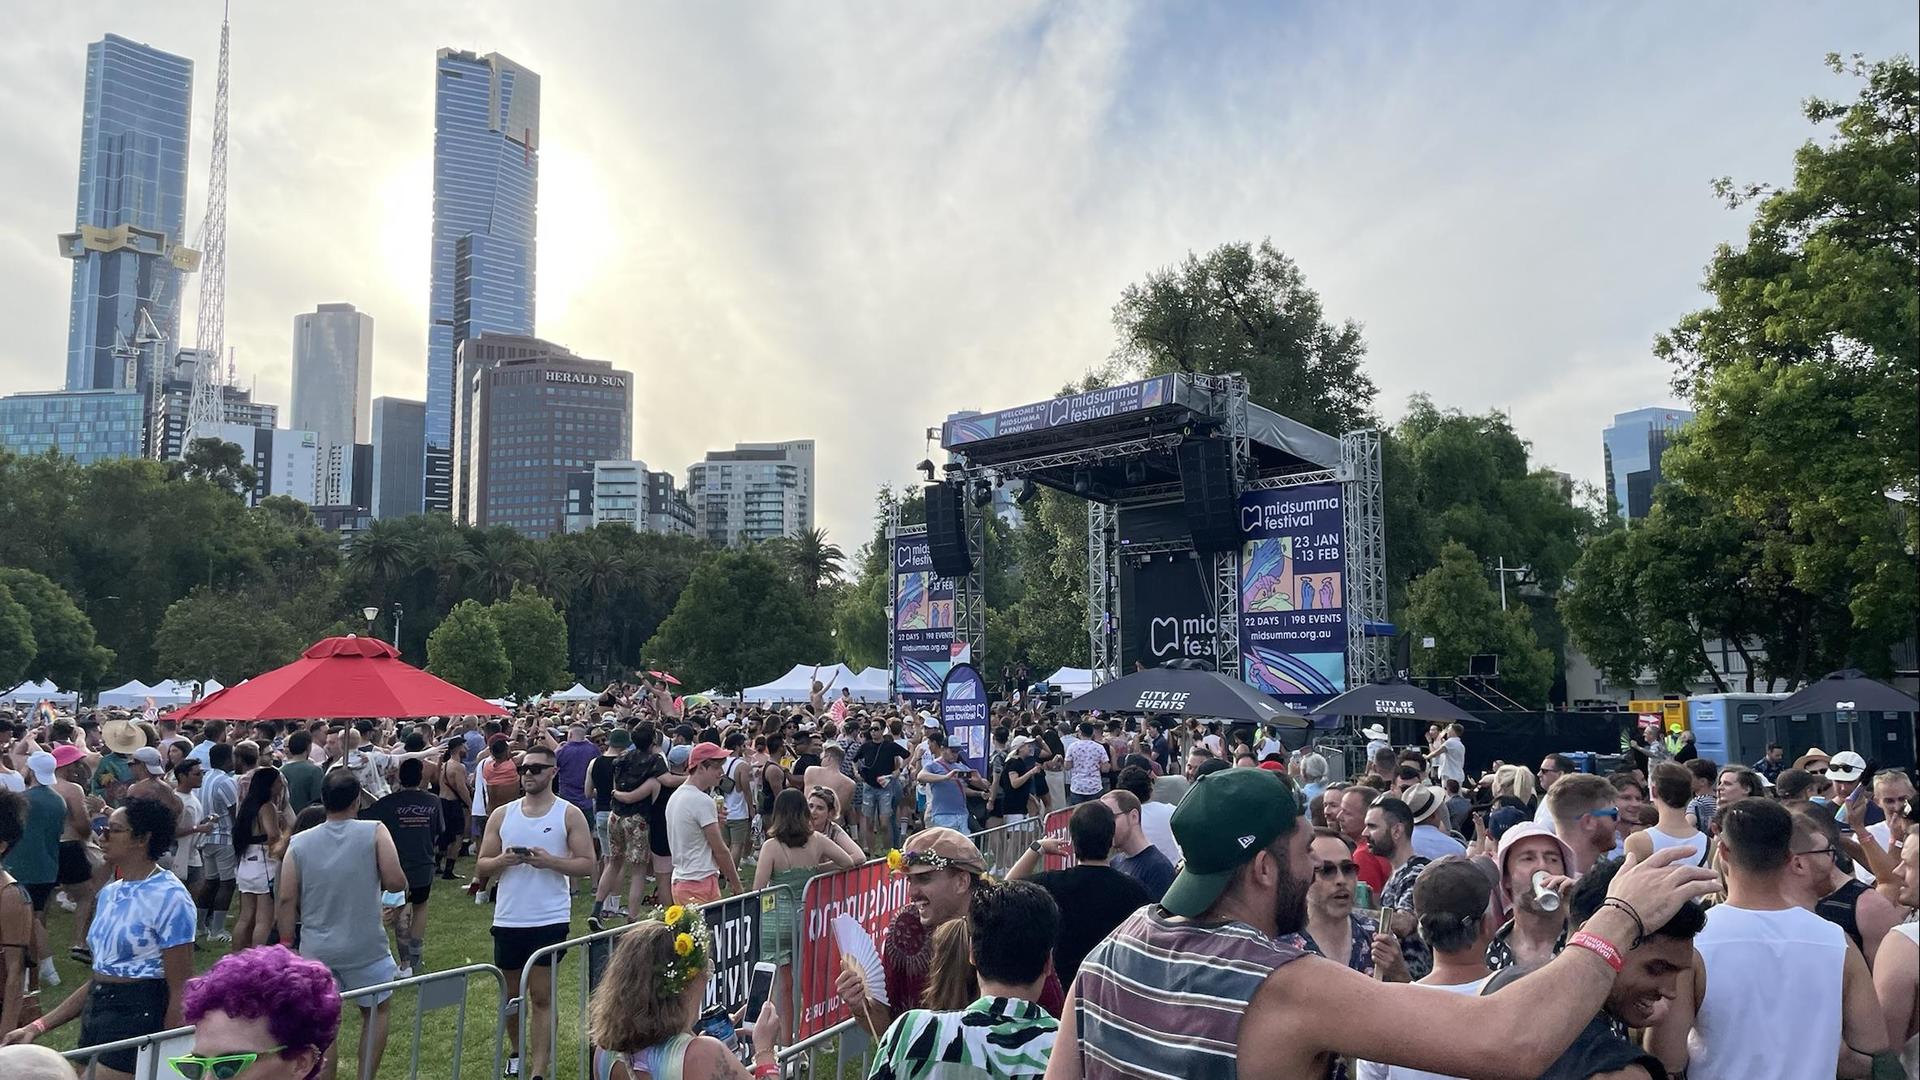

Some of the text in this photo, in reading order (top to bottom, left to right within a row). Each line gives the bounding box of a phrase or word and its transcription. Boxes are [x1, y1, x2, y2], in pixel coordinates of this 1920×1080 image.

[546, 372, 625, 386] HERALD SUN
[1071, 385, 1139, 409] midsumma
[1001, 408, 1034, 420] WELCOME
[1070, 402, 1114, 422] festival
[1000, 414, 1040, 427] MIDSUMMA
[999, 423, 1033, 434] CARNIVAL
[1264, 498, 1339, 516] midsumma
[1265, 513, 1313, 530] festival
[1295, 533, 1339, 548] 23 JAN
[1319, 548, 1339, 560] FEB
[942, 581, 953, 590] FEB
[1245, 614, 1342, 626] 22 DAYS 198 EVENTS
[1251, 629, 1331, 641] midsumma.org.au
[1140, 691, 1190, 701] CITY OF
[1135, 700, 1185, 710] EVENTS
